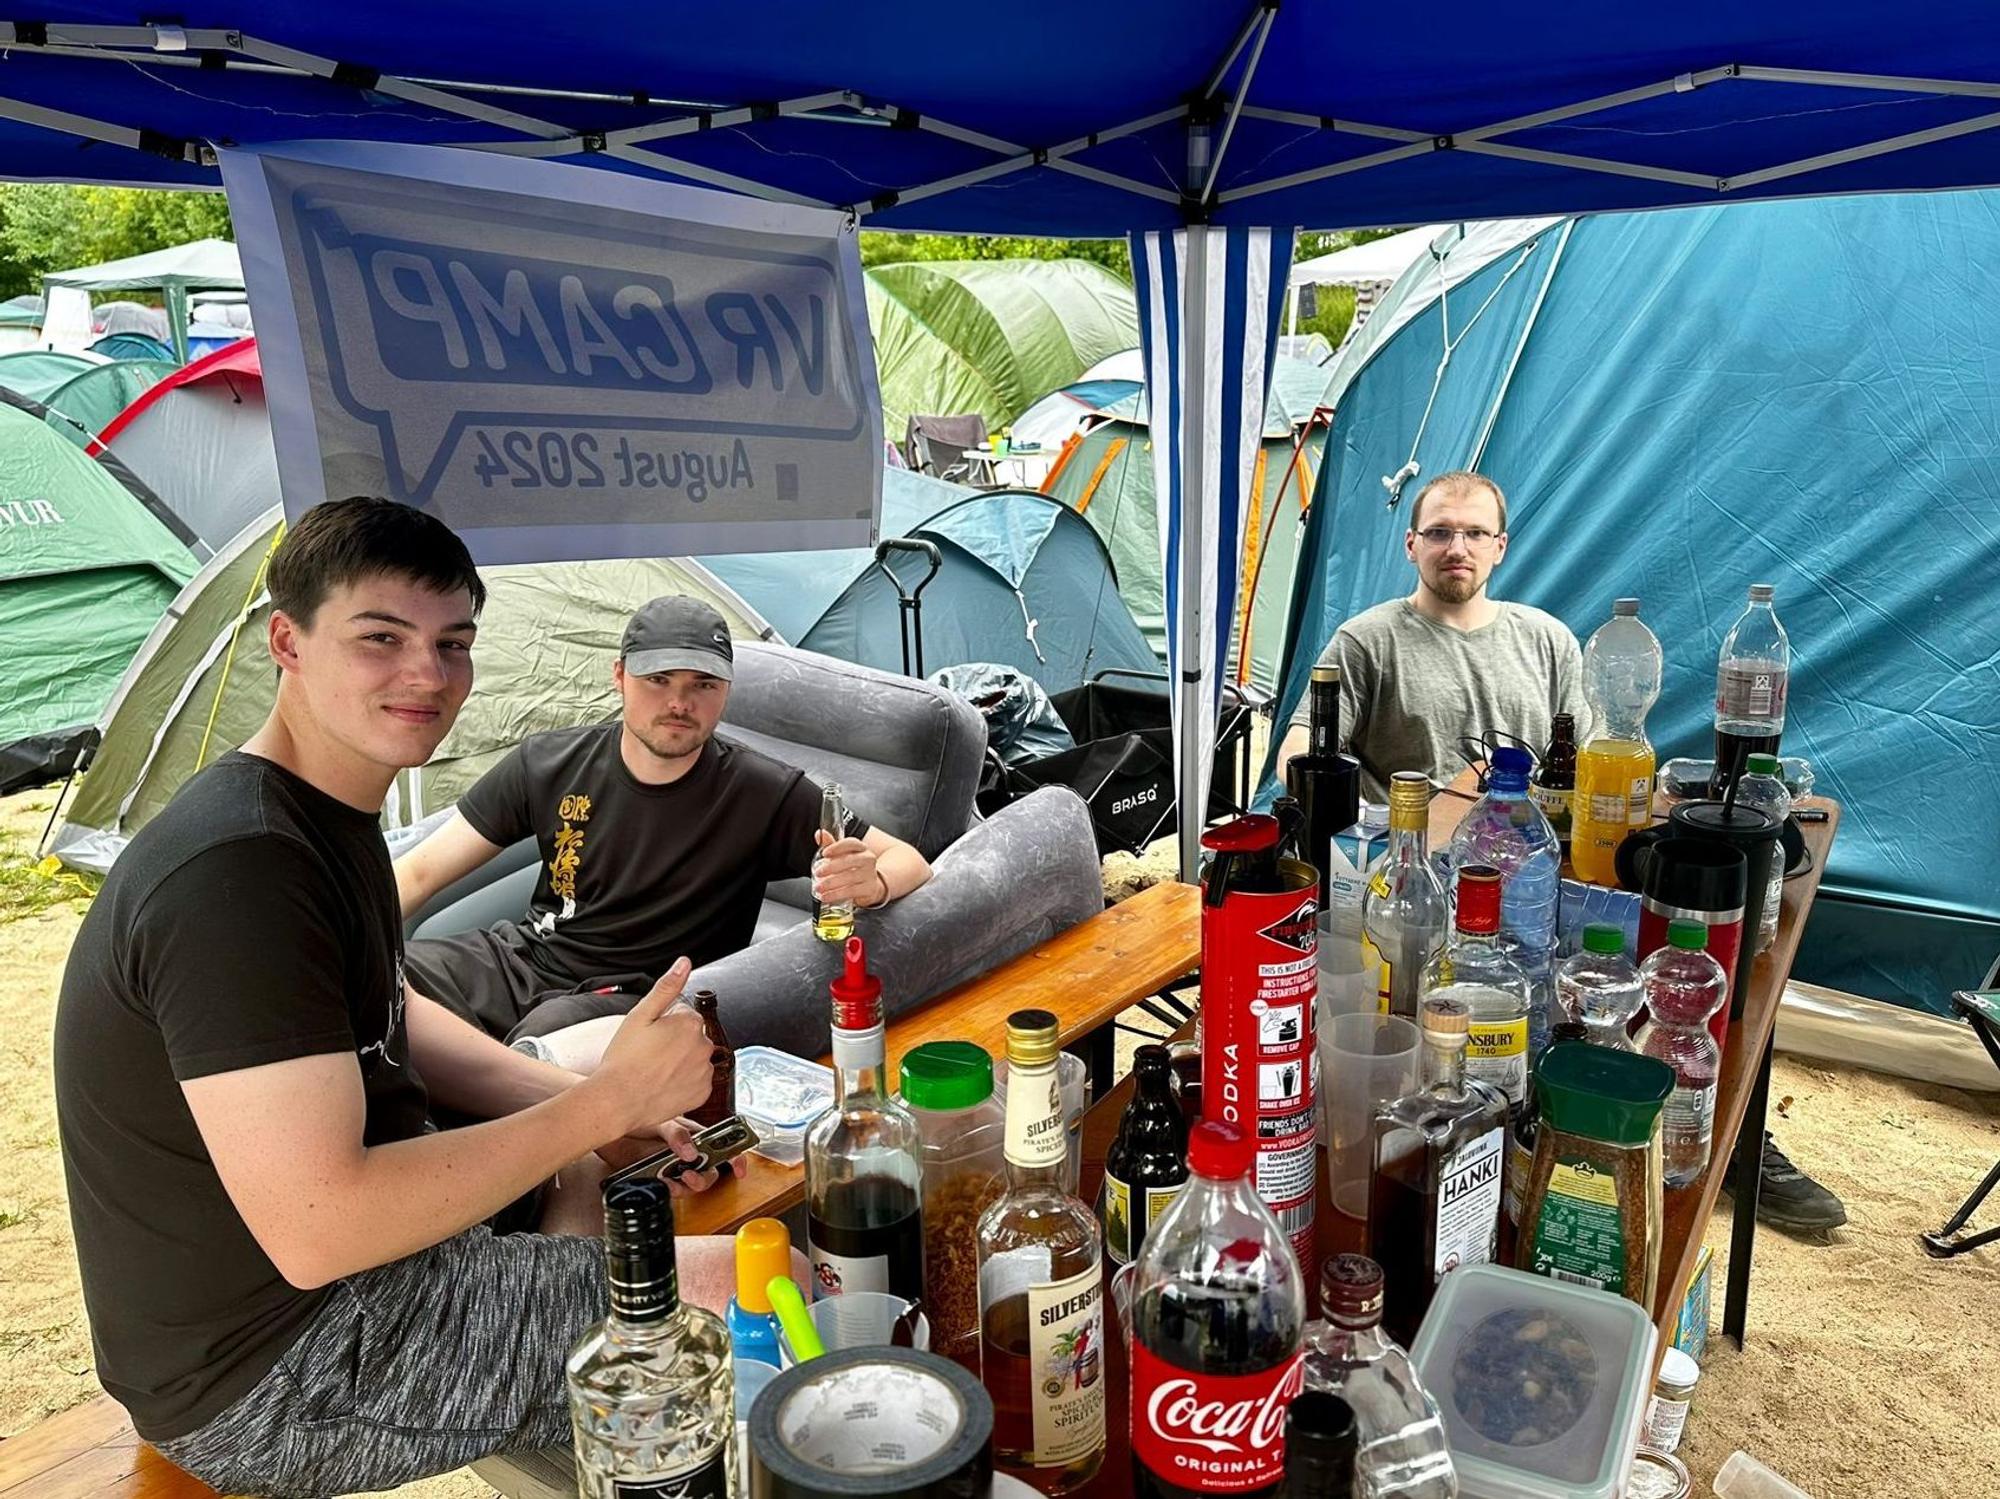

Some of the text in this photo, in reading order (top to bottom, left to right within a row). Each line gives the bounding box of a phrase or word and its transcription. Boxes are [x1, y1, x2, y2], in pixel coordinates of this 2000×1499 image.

[1112, 787, 1157, 815] BRASQ
[1468, 1032, 1514, 1046] NSBURY
[1223, 1044, 1238, 1122] ODKA
[1259, 1119, 1290, 1130] FRIENDS
[1443, 1154, 1499, 1202] HANKI
[1147, 1351, 1303, 1453] Coca-Co
[1174, 1455, 1266, 1473] ORIGINAL
